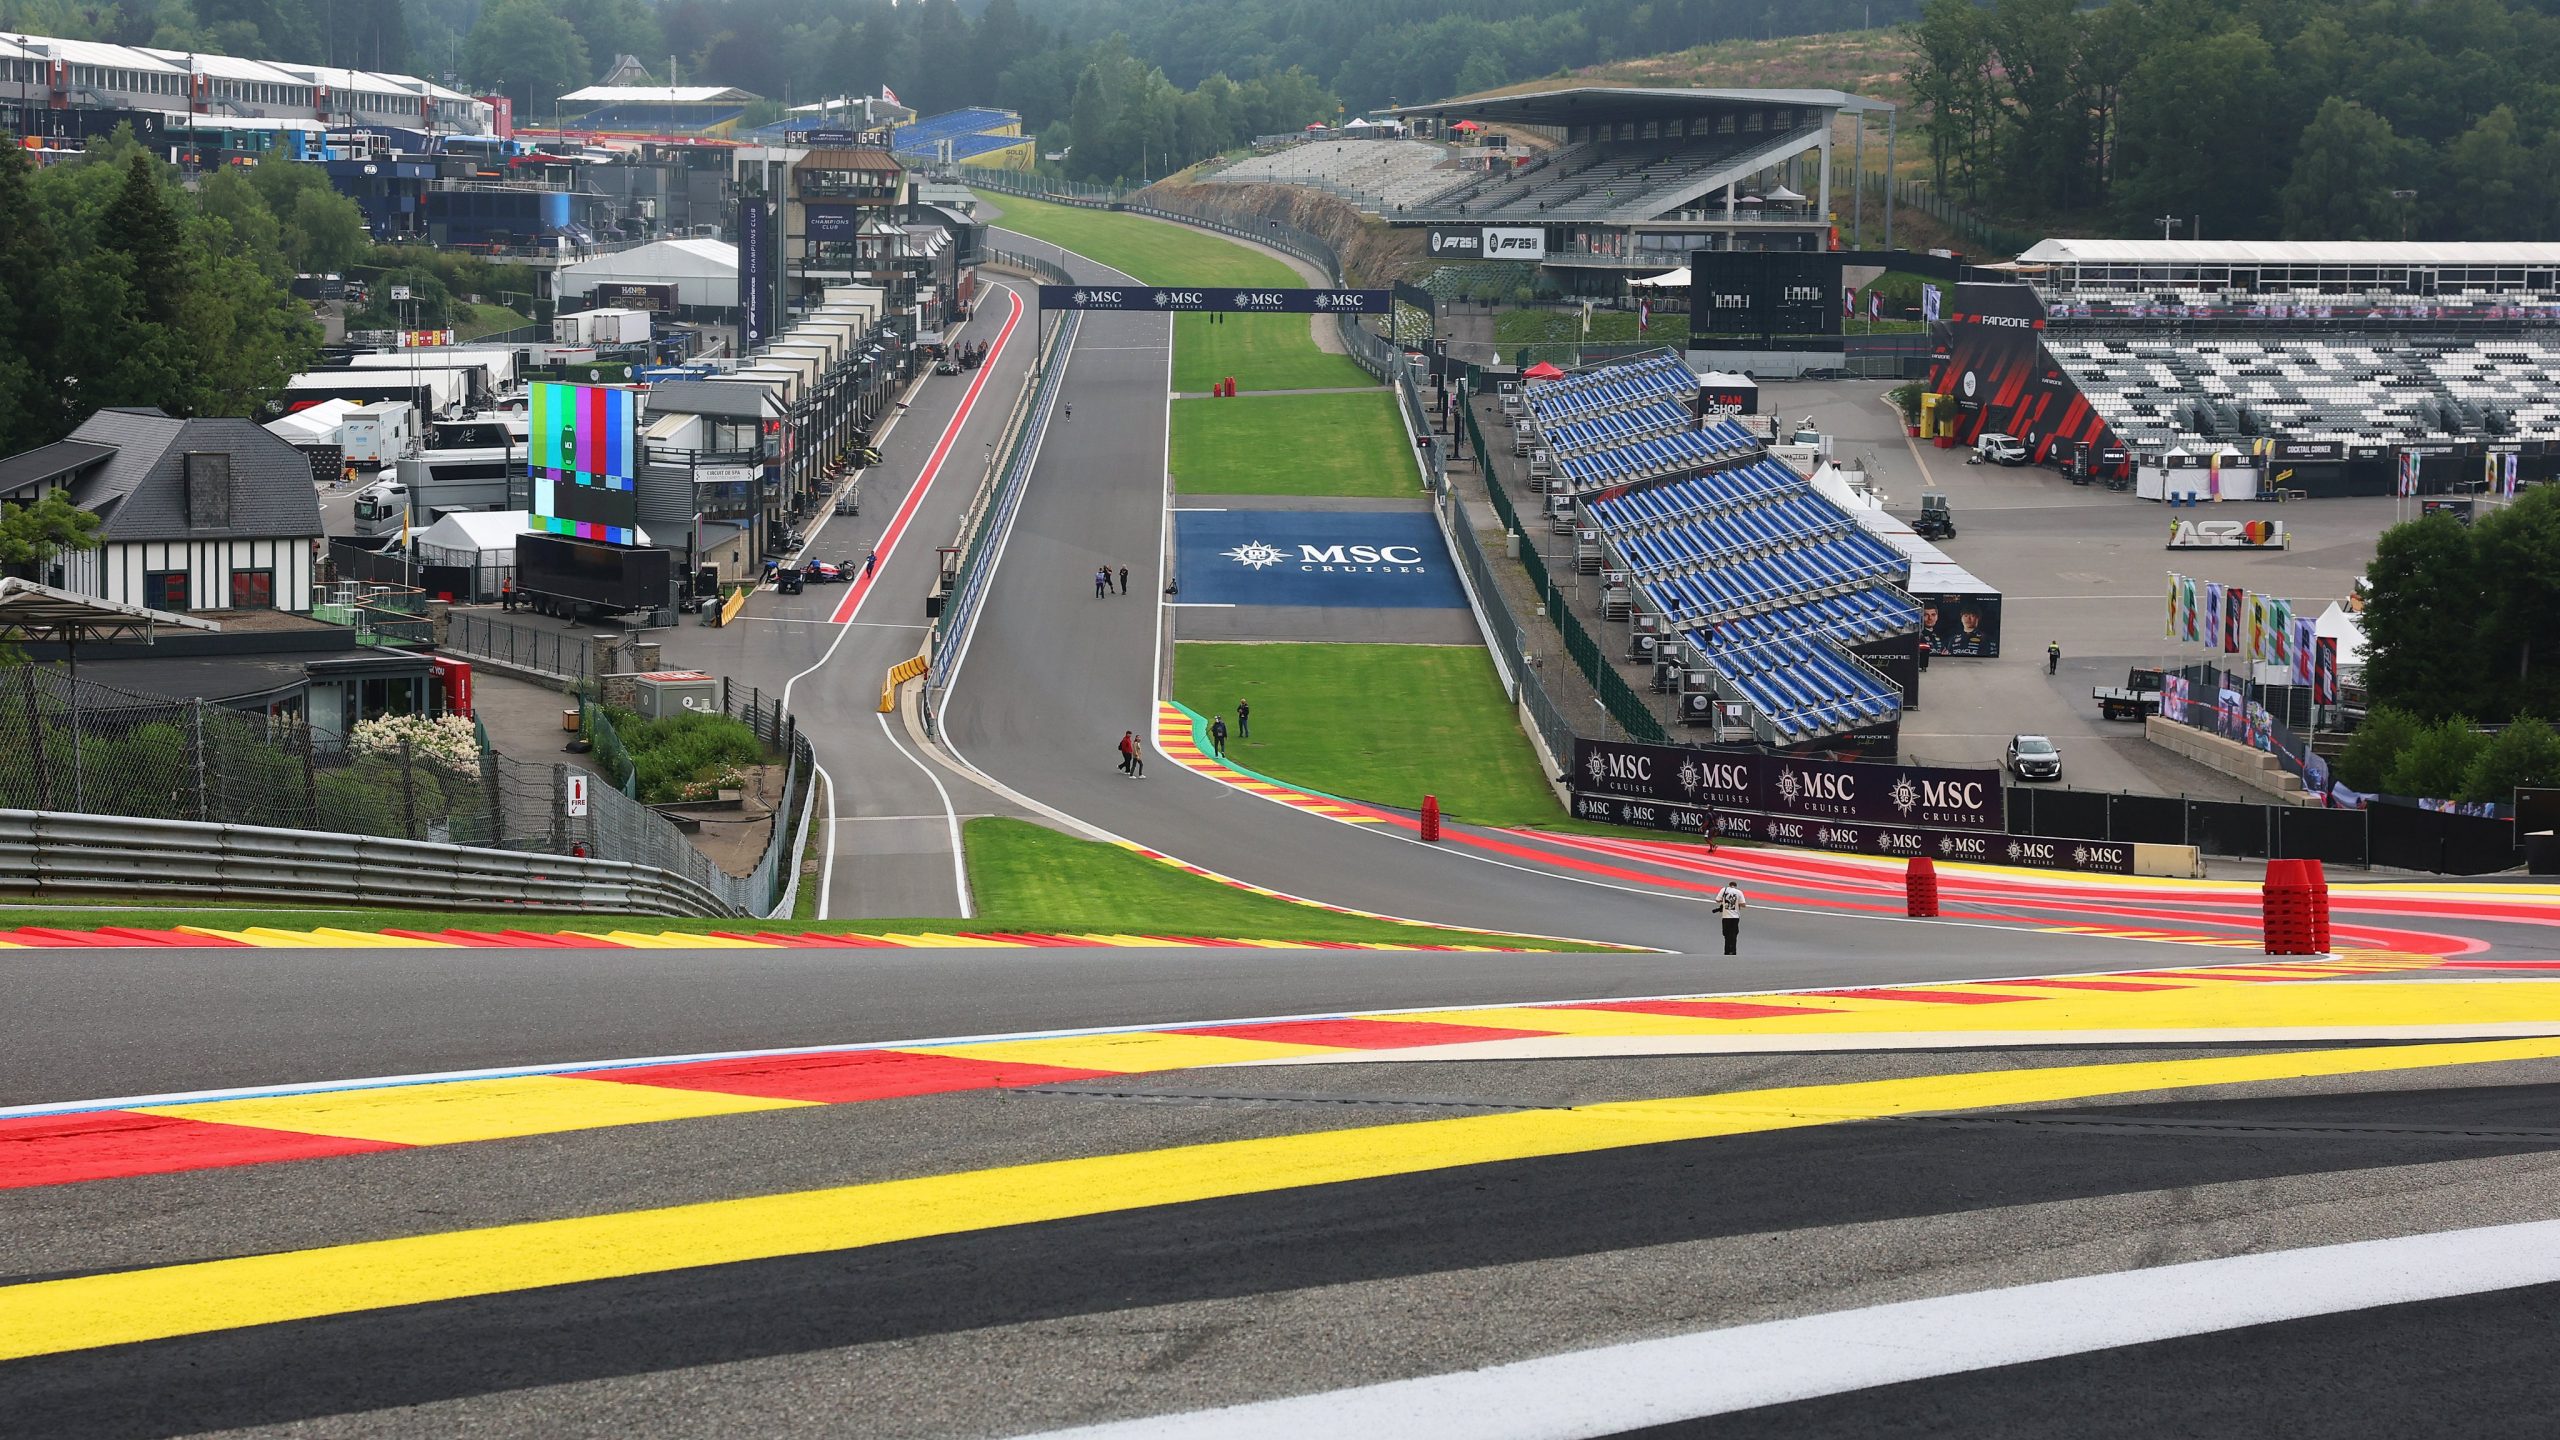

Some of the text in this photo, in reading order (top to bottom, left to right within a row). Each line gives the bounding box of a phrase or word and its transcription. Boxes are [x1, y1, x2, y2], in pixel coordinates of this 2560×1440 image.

[858, 132, 881, 144] 16°C
[1090, 291, 1121, 302] MSC
[1171, 292, 1202, 303] MSC
[1251, 294, 1282, 305] MSC
[1332, 295, 1363, 305] MSC
[1982, 315, 2029, 328] FANZONE
[1720, 395, 1742, 404] FAN
[1713, 405, 1742, 414] SHOP
[1298, 544, 1422, 564] MSC
[435, 666, 444, 675] YOU
[1608, 753, 1651, 780] MSC
[1702, 763, 1748, 790] MSC
[1610, 782, 1653, 793] CRUISES
[1802, 772, 1854, 800] MSC
[1703, 792, 1749, 803] CRUISES
[1922, 780, 1983, 809] MSC
[1588, 801, 1610, 815] MSC
[1633, 806, 1655, 820] MSC
[1804, 802, 1856, 815] CRUISES
[1681, 812, 1703, 826] MSC
[1728, 817, 1751, 831] MSC
[1923, 812, 1984, 823] CRUISES
[1779, 823, 1803, 838] MSC
[1830, 828, 1858, 843] MSC
[1893, 833, 1922, 848] MSC
[1955, 837, 1985, 852] MSC
[2023, 843, 2054, 858] MSC
[2090, 847, 2122, 863] MSC
